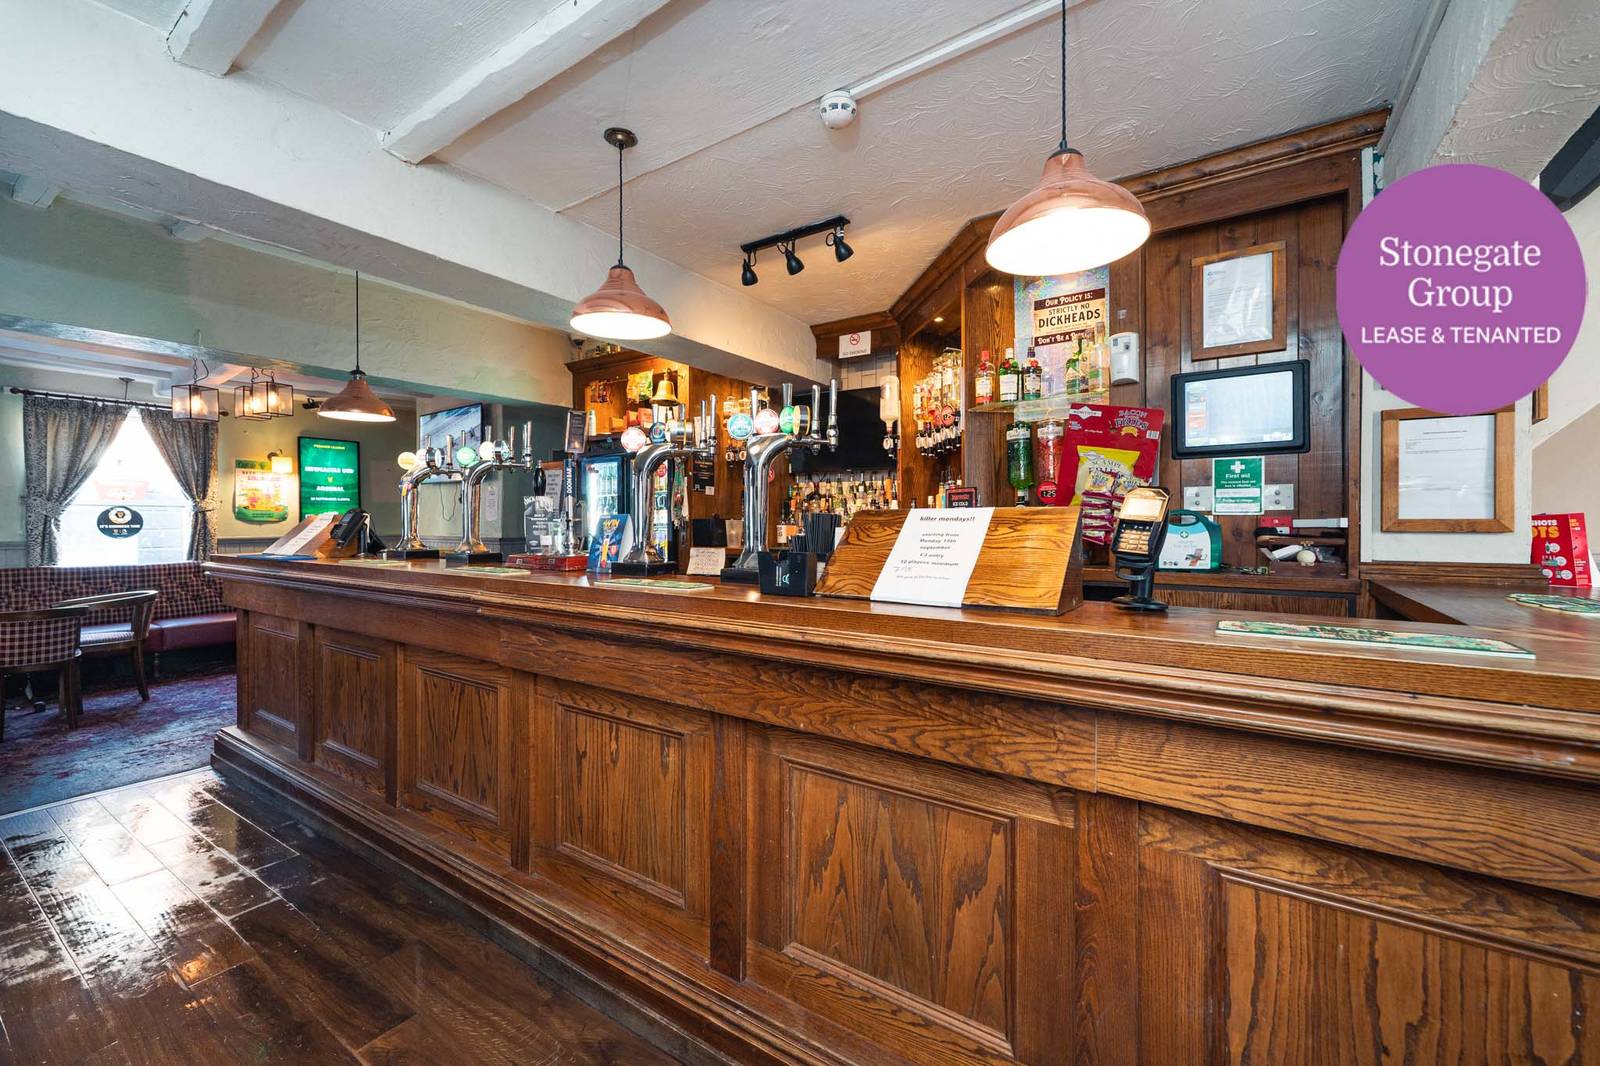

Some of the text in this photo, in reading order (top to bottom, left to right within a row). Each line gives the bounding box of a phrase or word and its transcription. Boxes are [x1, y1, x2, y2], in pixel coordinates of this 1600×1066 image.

[1060, 294, 1083, 304] POLICY
[1048, 305, 1078, 316] STRICTLY
[1038, 308, 1100, 328] DICKHEADS
